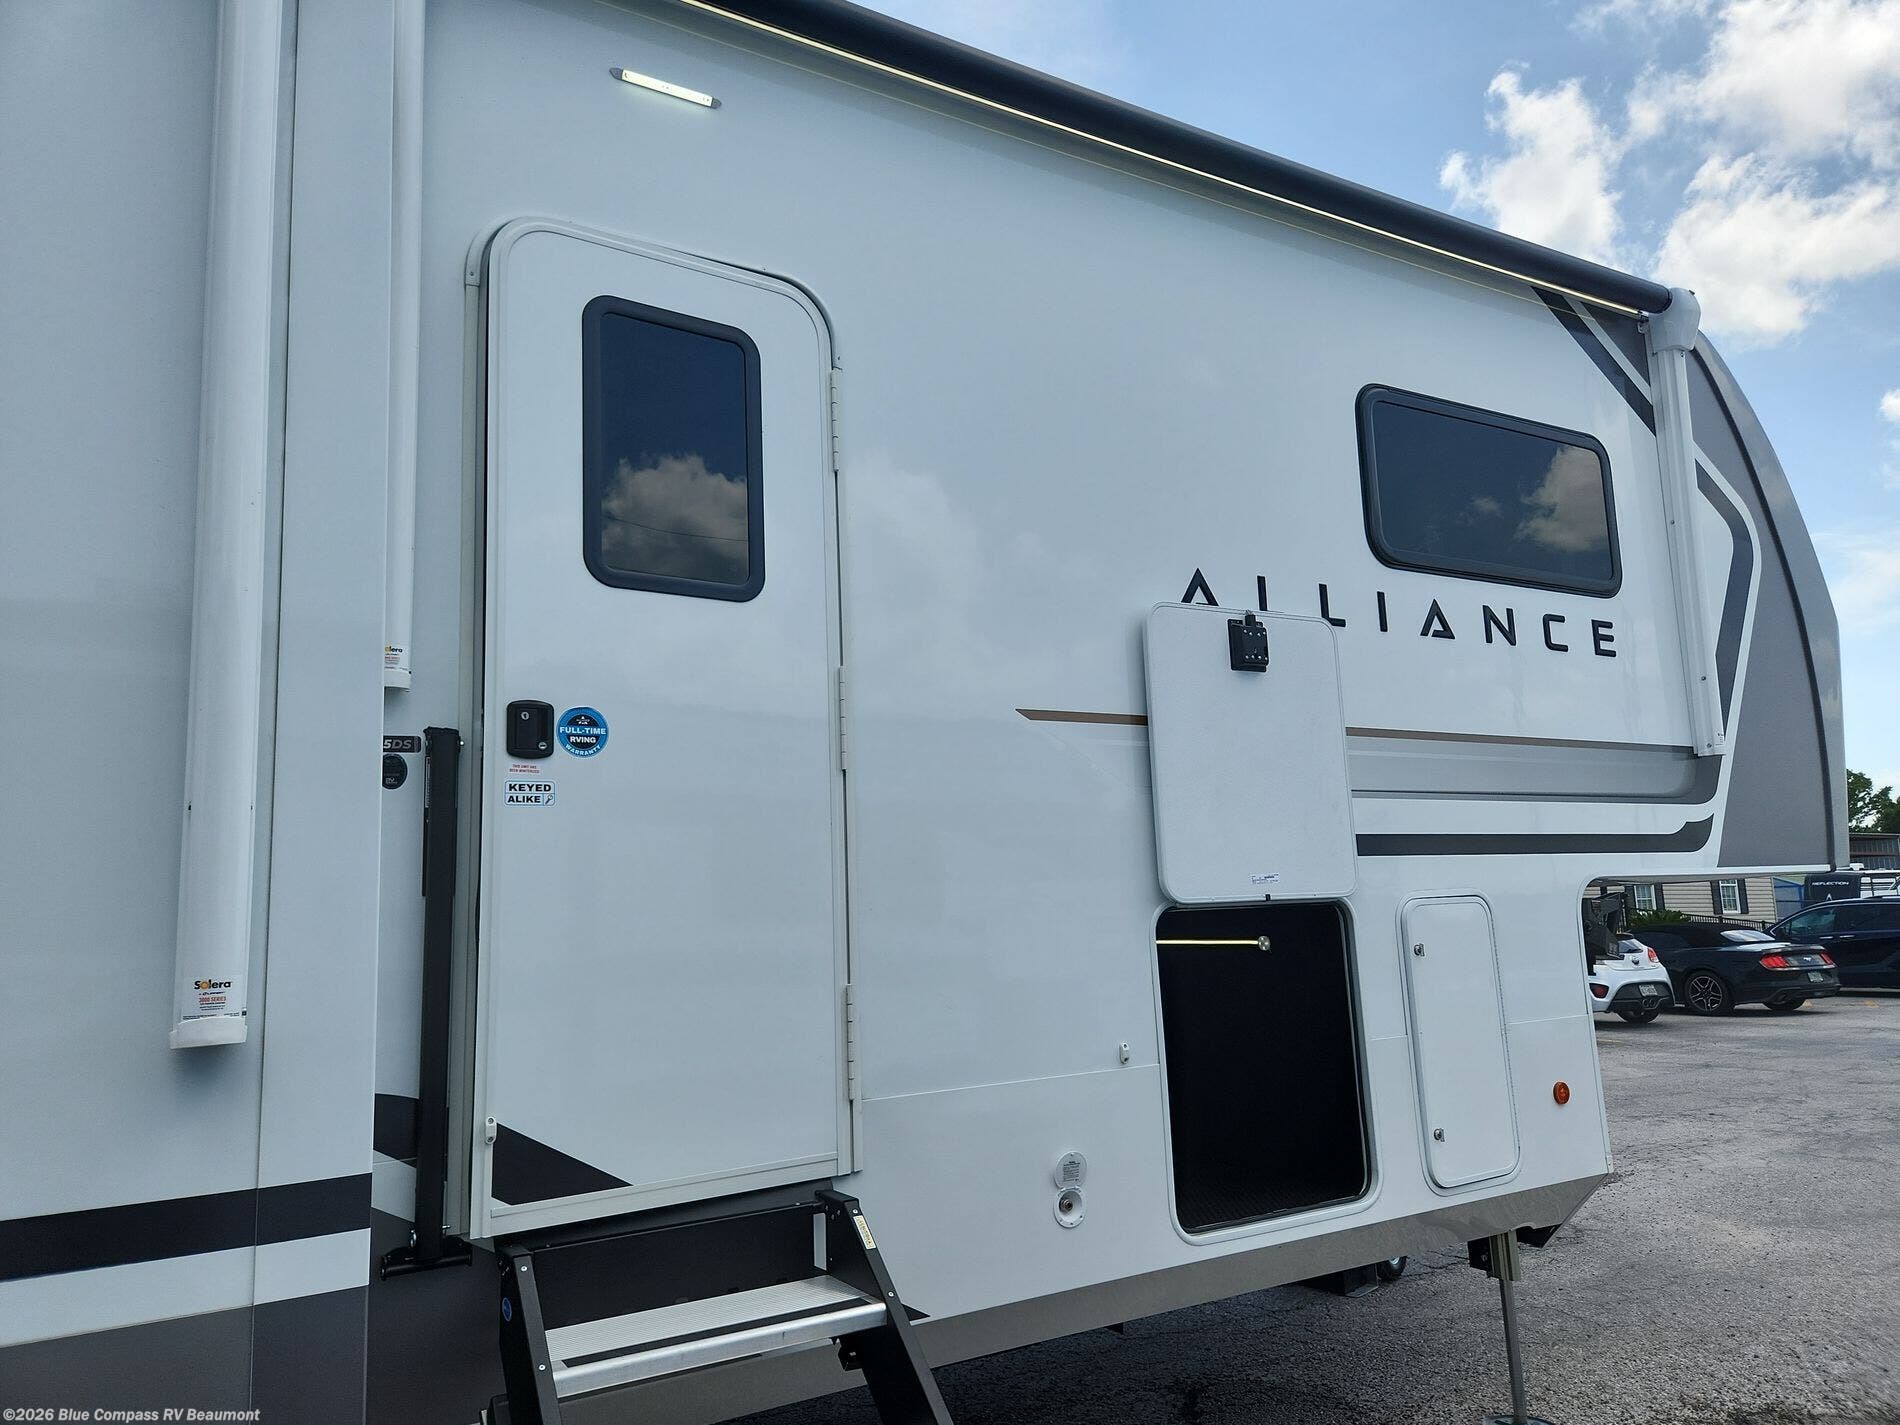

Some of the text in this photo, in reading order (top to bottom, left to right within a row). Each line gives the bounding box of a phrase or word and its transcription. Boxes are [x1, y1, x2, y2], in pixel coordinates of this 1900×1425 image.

[1181, 567, 1617, 658] ALLIANCE
[559, 726, 607, 735] FULL-TIME
[566, 744, 601, 756] WARRANTY
[508, 783, 552, 792] KEYED
[507, 795, 541, 803] ALIKE
[194, 979, 232, 990] Solera
